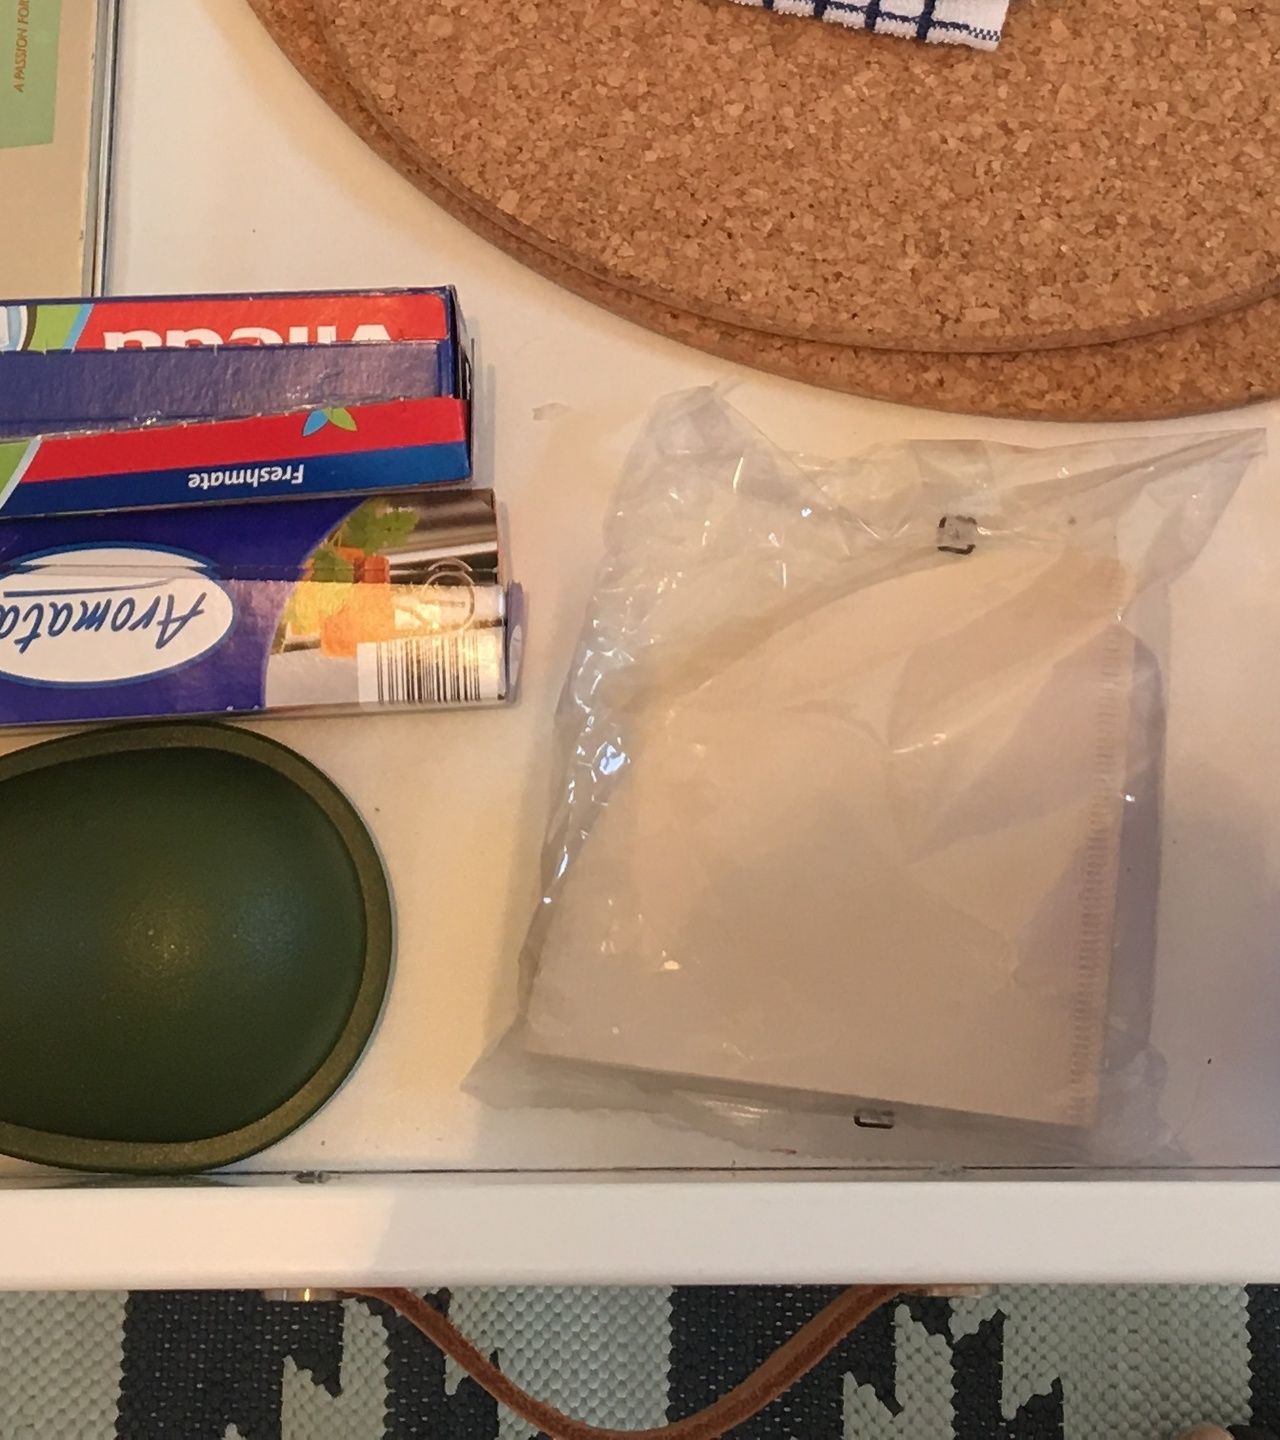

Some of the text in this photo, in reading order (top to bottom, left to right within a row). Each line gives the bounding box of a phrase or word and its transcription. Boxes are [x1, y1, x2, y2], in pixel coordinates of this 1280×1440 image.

[17, 0, 30, 25] FOR
[13, 28, 28, 80] PASSION
[13, 83, 25, 93] A
[187, 462, 305, 492] Freshmate
